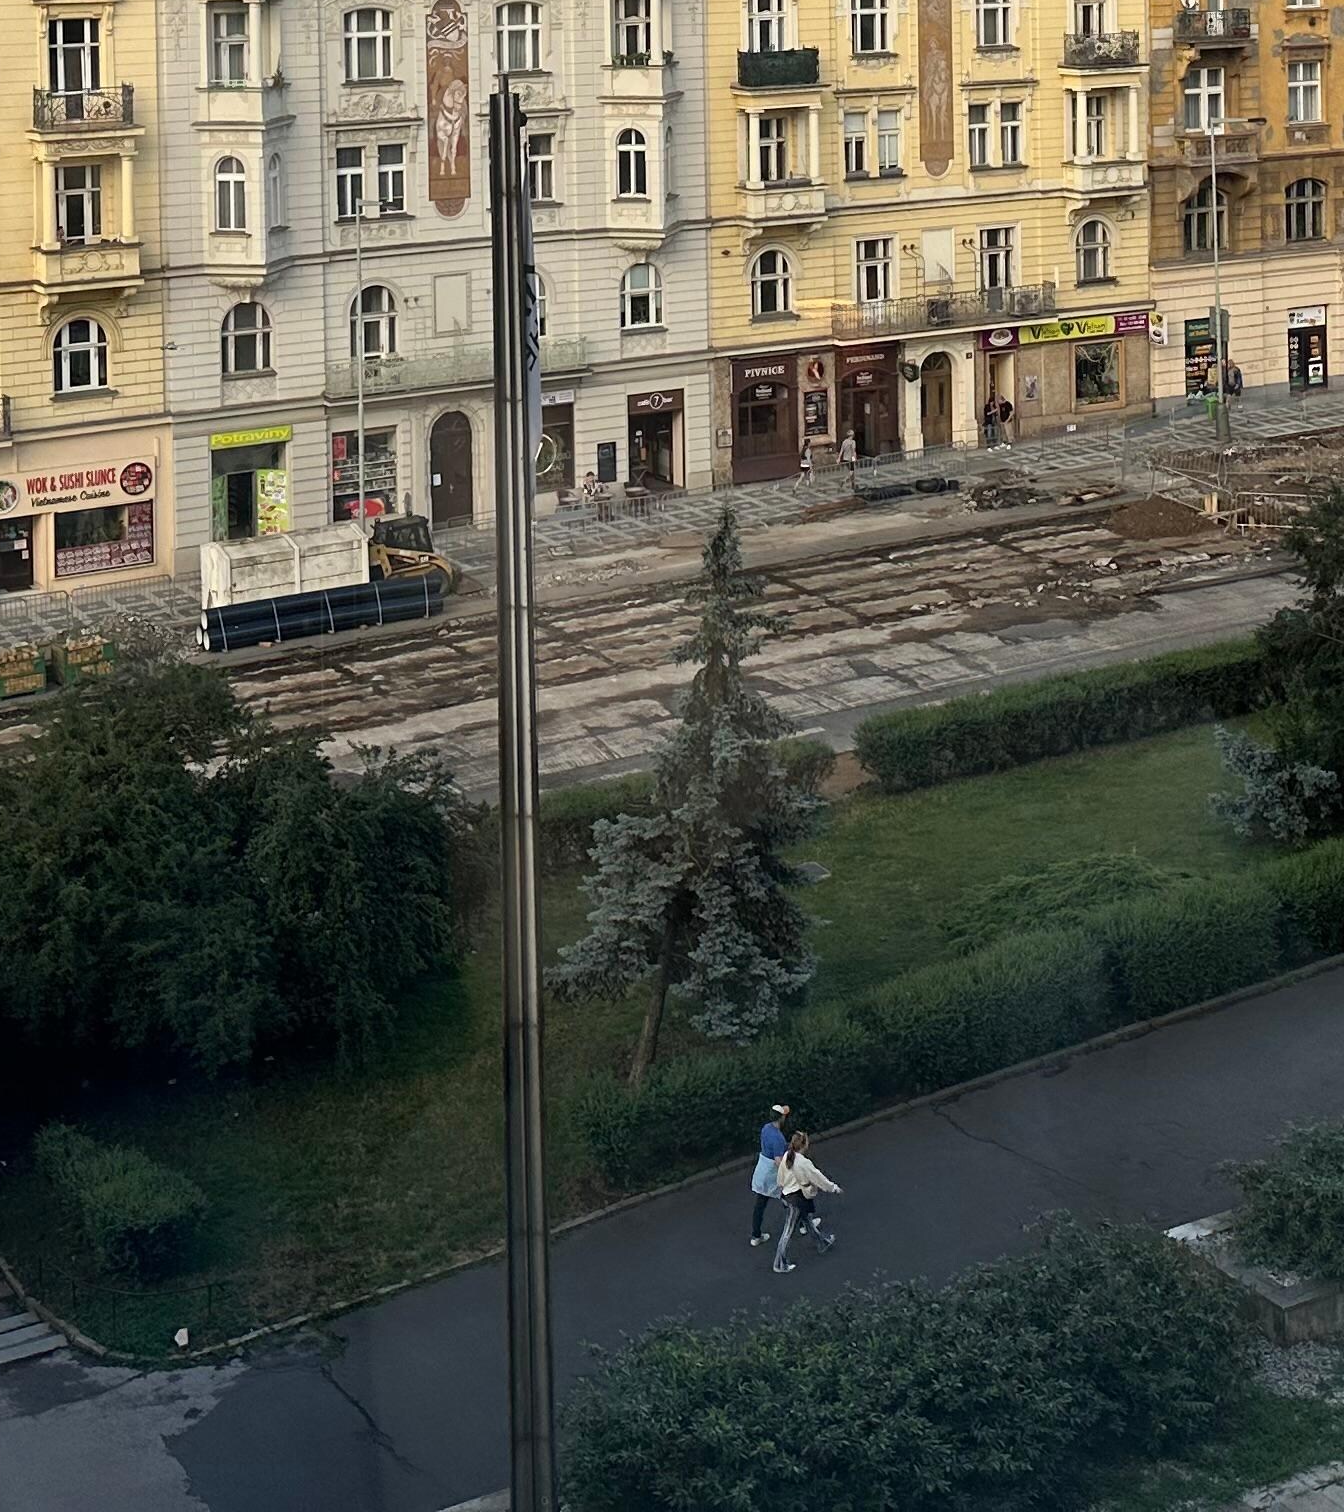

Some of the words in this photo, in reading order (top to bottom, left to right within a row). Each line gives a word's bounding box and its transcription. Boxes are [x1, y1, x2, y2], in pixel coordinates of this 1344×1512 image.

[744, 365, 785, 378] PIVNICE
[211, 427, 290, 446] Potraviny
[26, 476, 49, 495] WOK
[50, 476, 57, 492] &
[59, 471, 84, 491] SUSHI
[86, 467, 117, 488] SLUNCE
